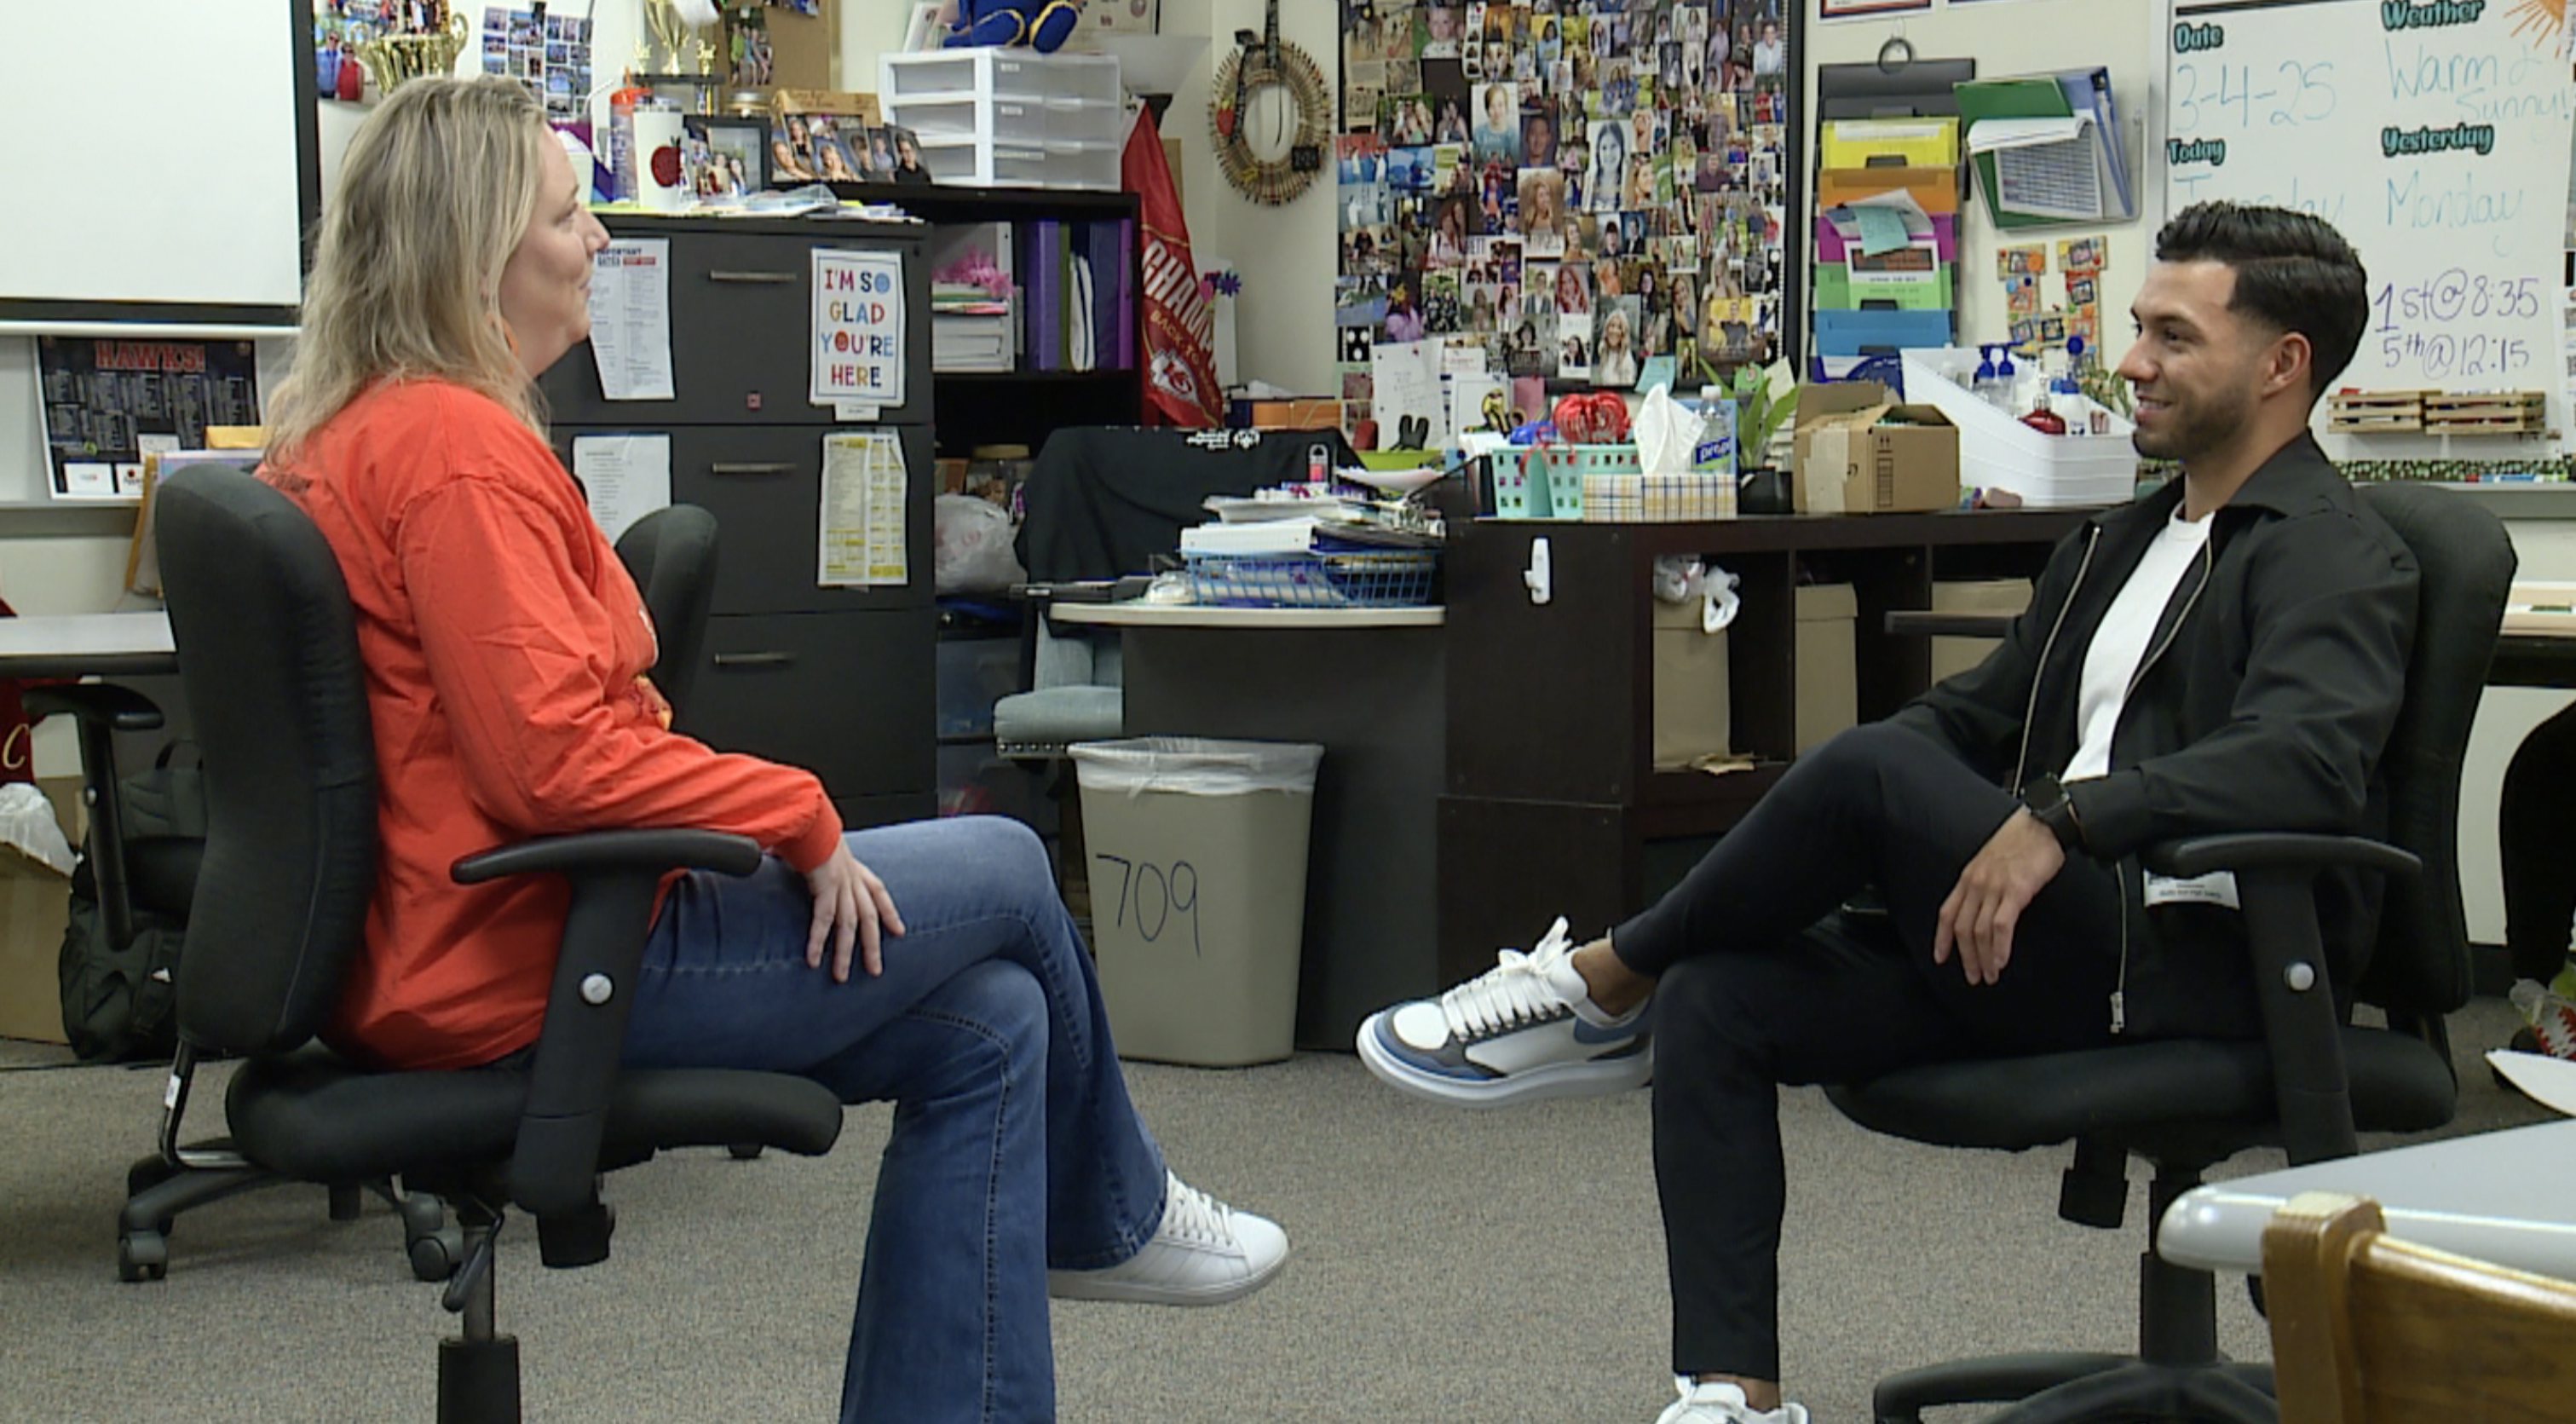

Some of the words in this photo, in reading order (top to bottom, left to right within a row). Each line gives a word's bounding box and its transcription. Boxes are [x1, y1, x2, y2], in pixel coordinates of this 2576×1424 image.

[2381, 0, 2486, 31] Weather
[2175, 21, 2224, 53] Date
[2385, 38, 2498, 99] Warm
[2175, 61, 2336, 131] 3-4-25
[2167, 137, 2226, 165] Today
[2382, 122, 2494, 158] Yesterday
[2387, 170, 2523, 257] Monday
[825, 269, 855, 291] I'M
[860, 271, 890, 293] SO
[829, 300, 885, 325] GLAD
[95, 341, 205, 373] HAWKS!
[820, 330, 895, 357] YOU'RE
[831, 364, 882, 388] HERE
[1096, 853, 1202, 958] 709
